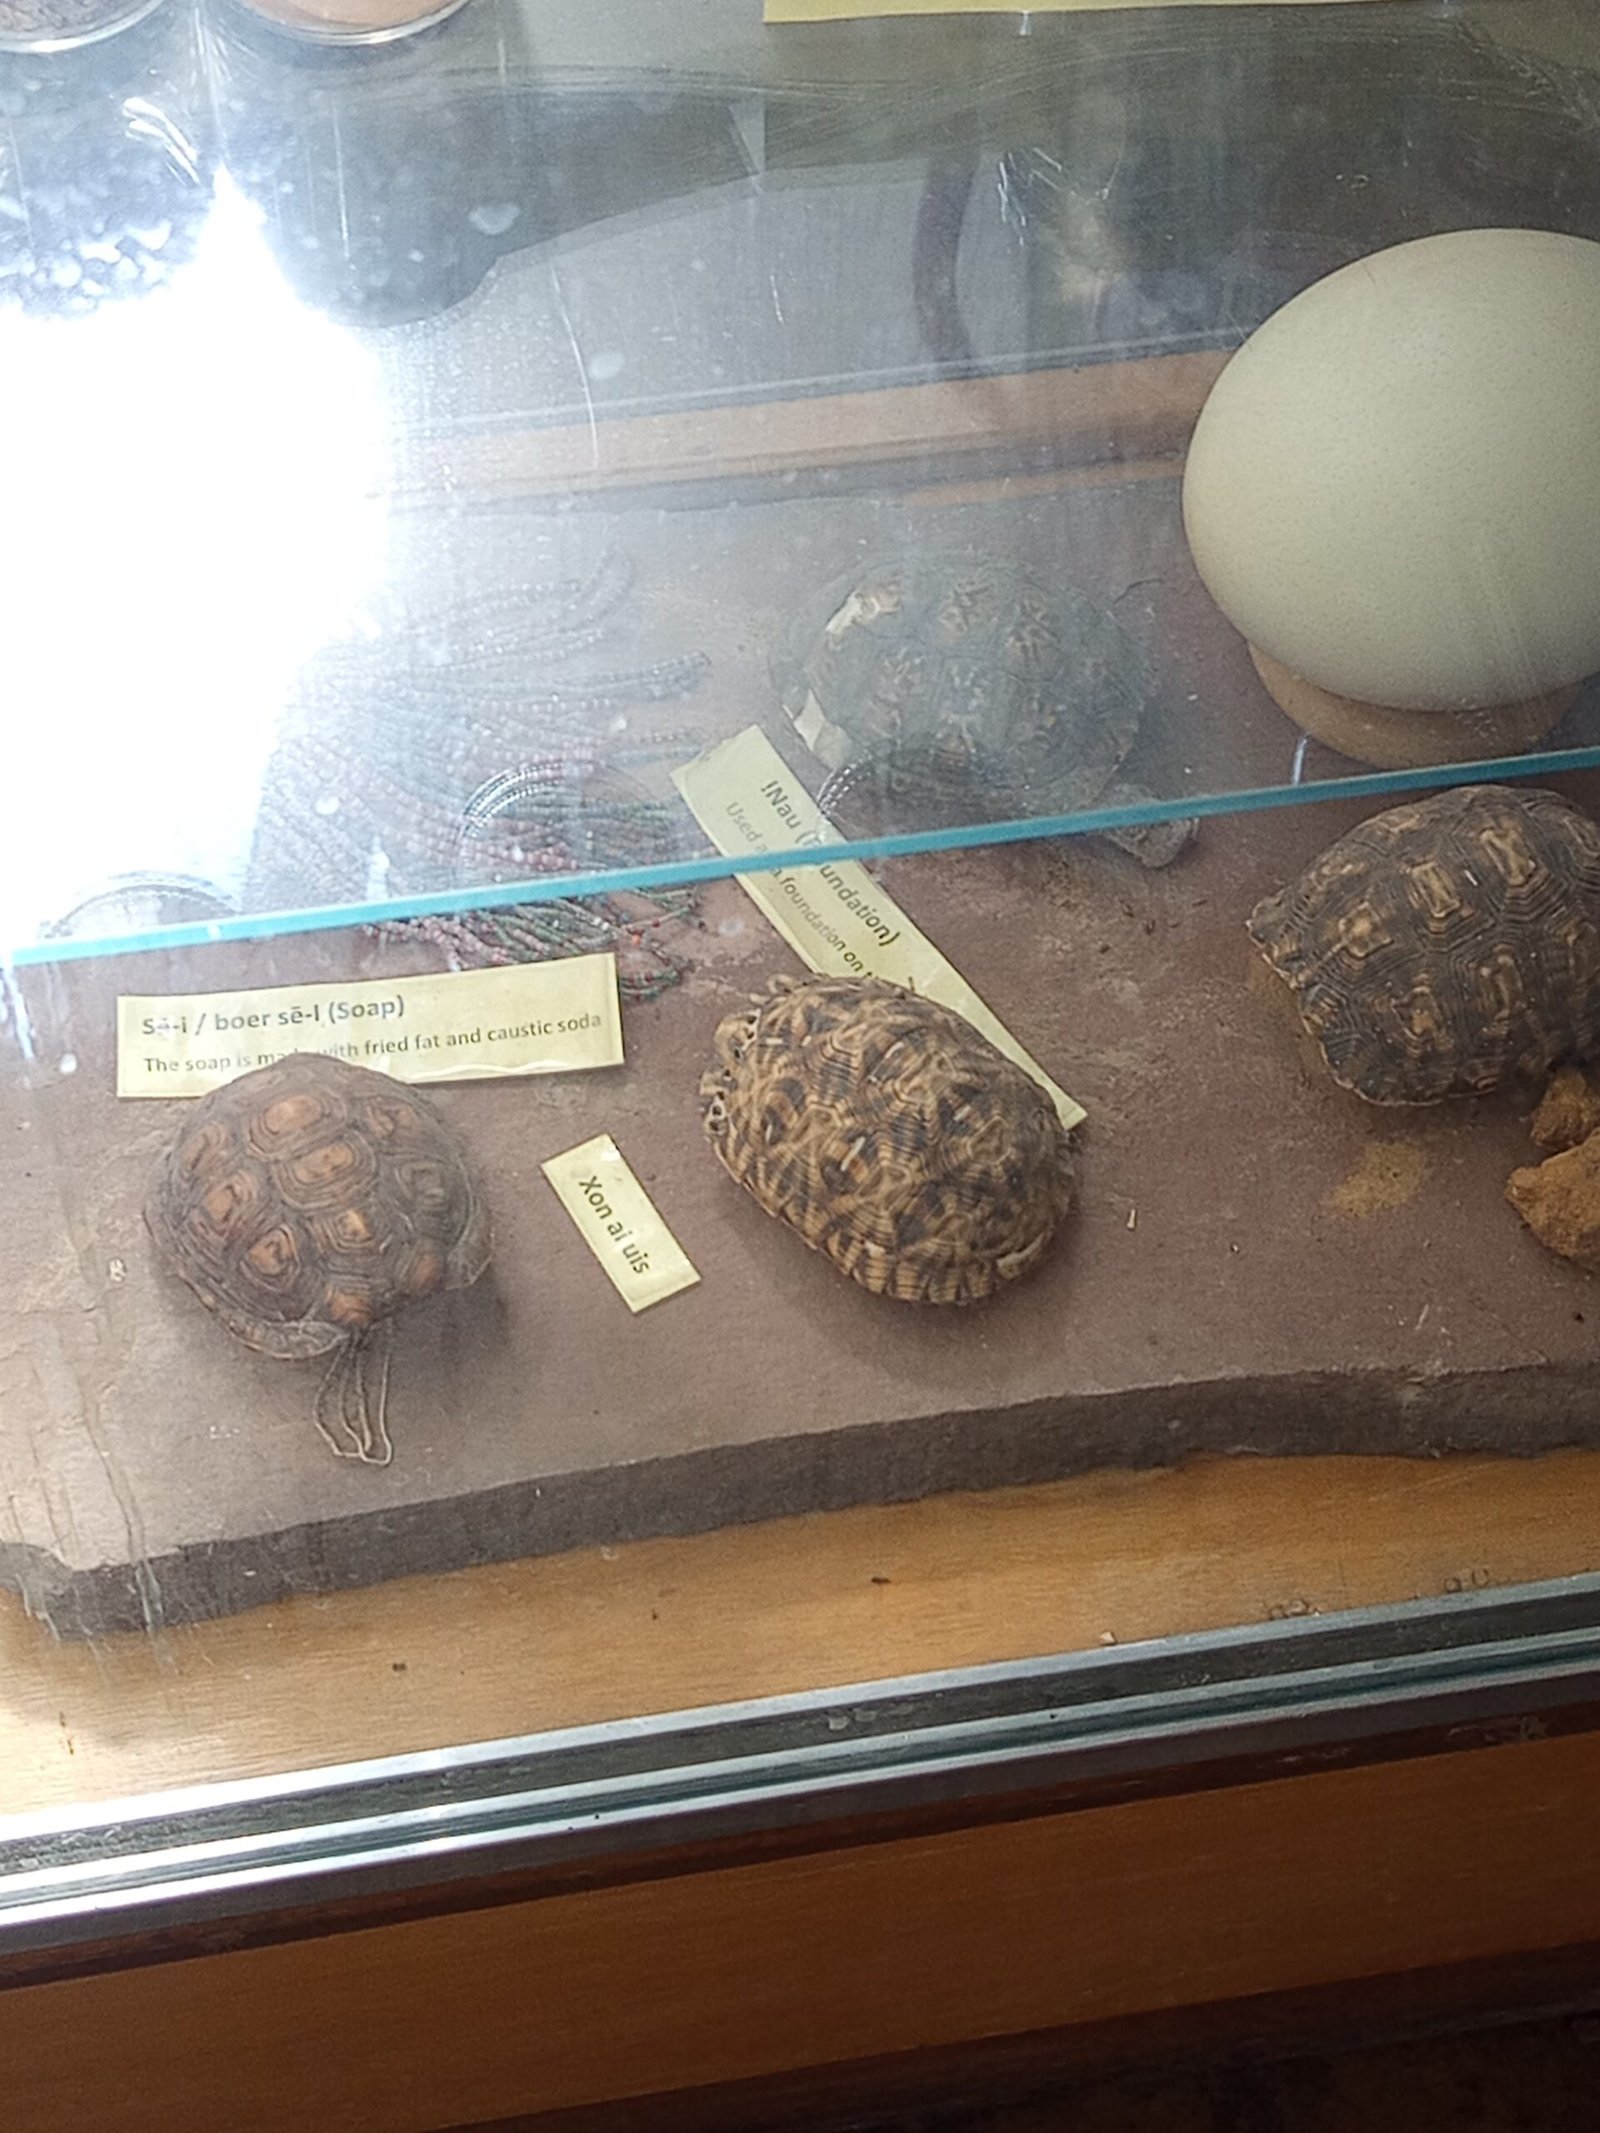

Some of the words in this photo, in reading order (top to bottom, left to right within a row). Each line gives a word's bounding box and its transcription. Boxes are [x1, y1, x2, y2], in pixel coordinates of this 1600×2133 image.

[726, 802, 763, 842] Used
[779, 877, 846, 951] foundation
[843, 952, 864, 972] on
[144, 1057, 180, 1073] The
[185, 1057, 231, 1072] soap
[236, 1054, 251, 1068] is
[365, 1036, 408, 1055] fried
[415, 1033, 441, 1049] fat
[446, 1027, 482, 1046] and
[487, 1020, 553, 1042] caustic
[558, 1013, 602, 1033] soda
[215, 1013, 271, 1031] boer
[328, 994, 405, 1024] (Soap)
[578, 1175, 612, 1220] Xon
[607, 1221, 633, 1242] ai
[622, 1243, 650, 1275] uis
